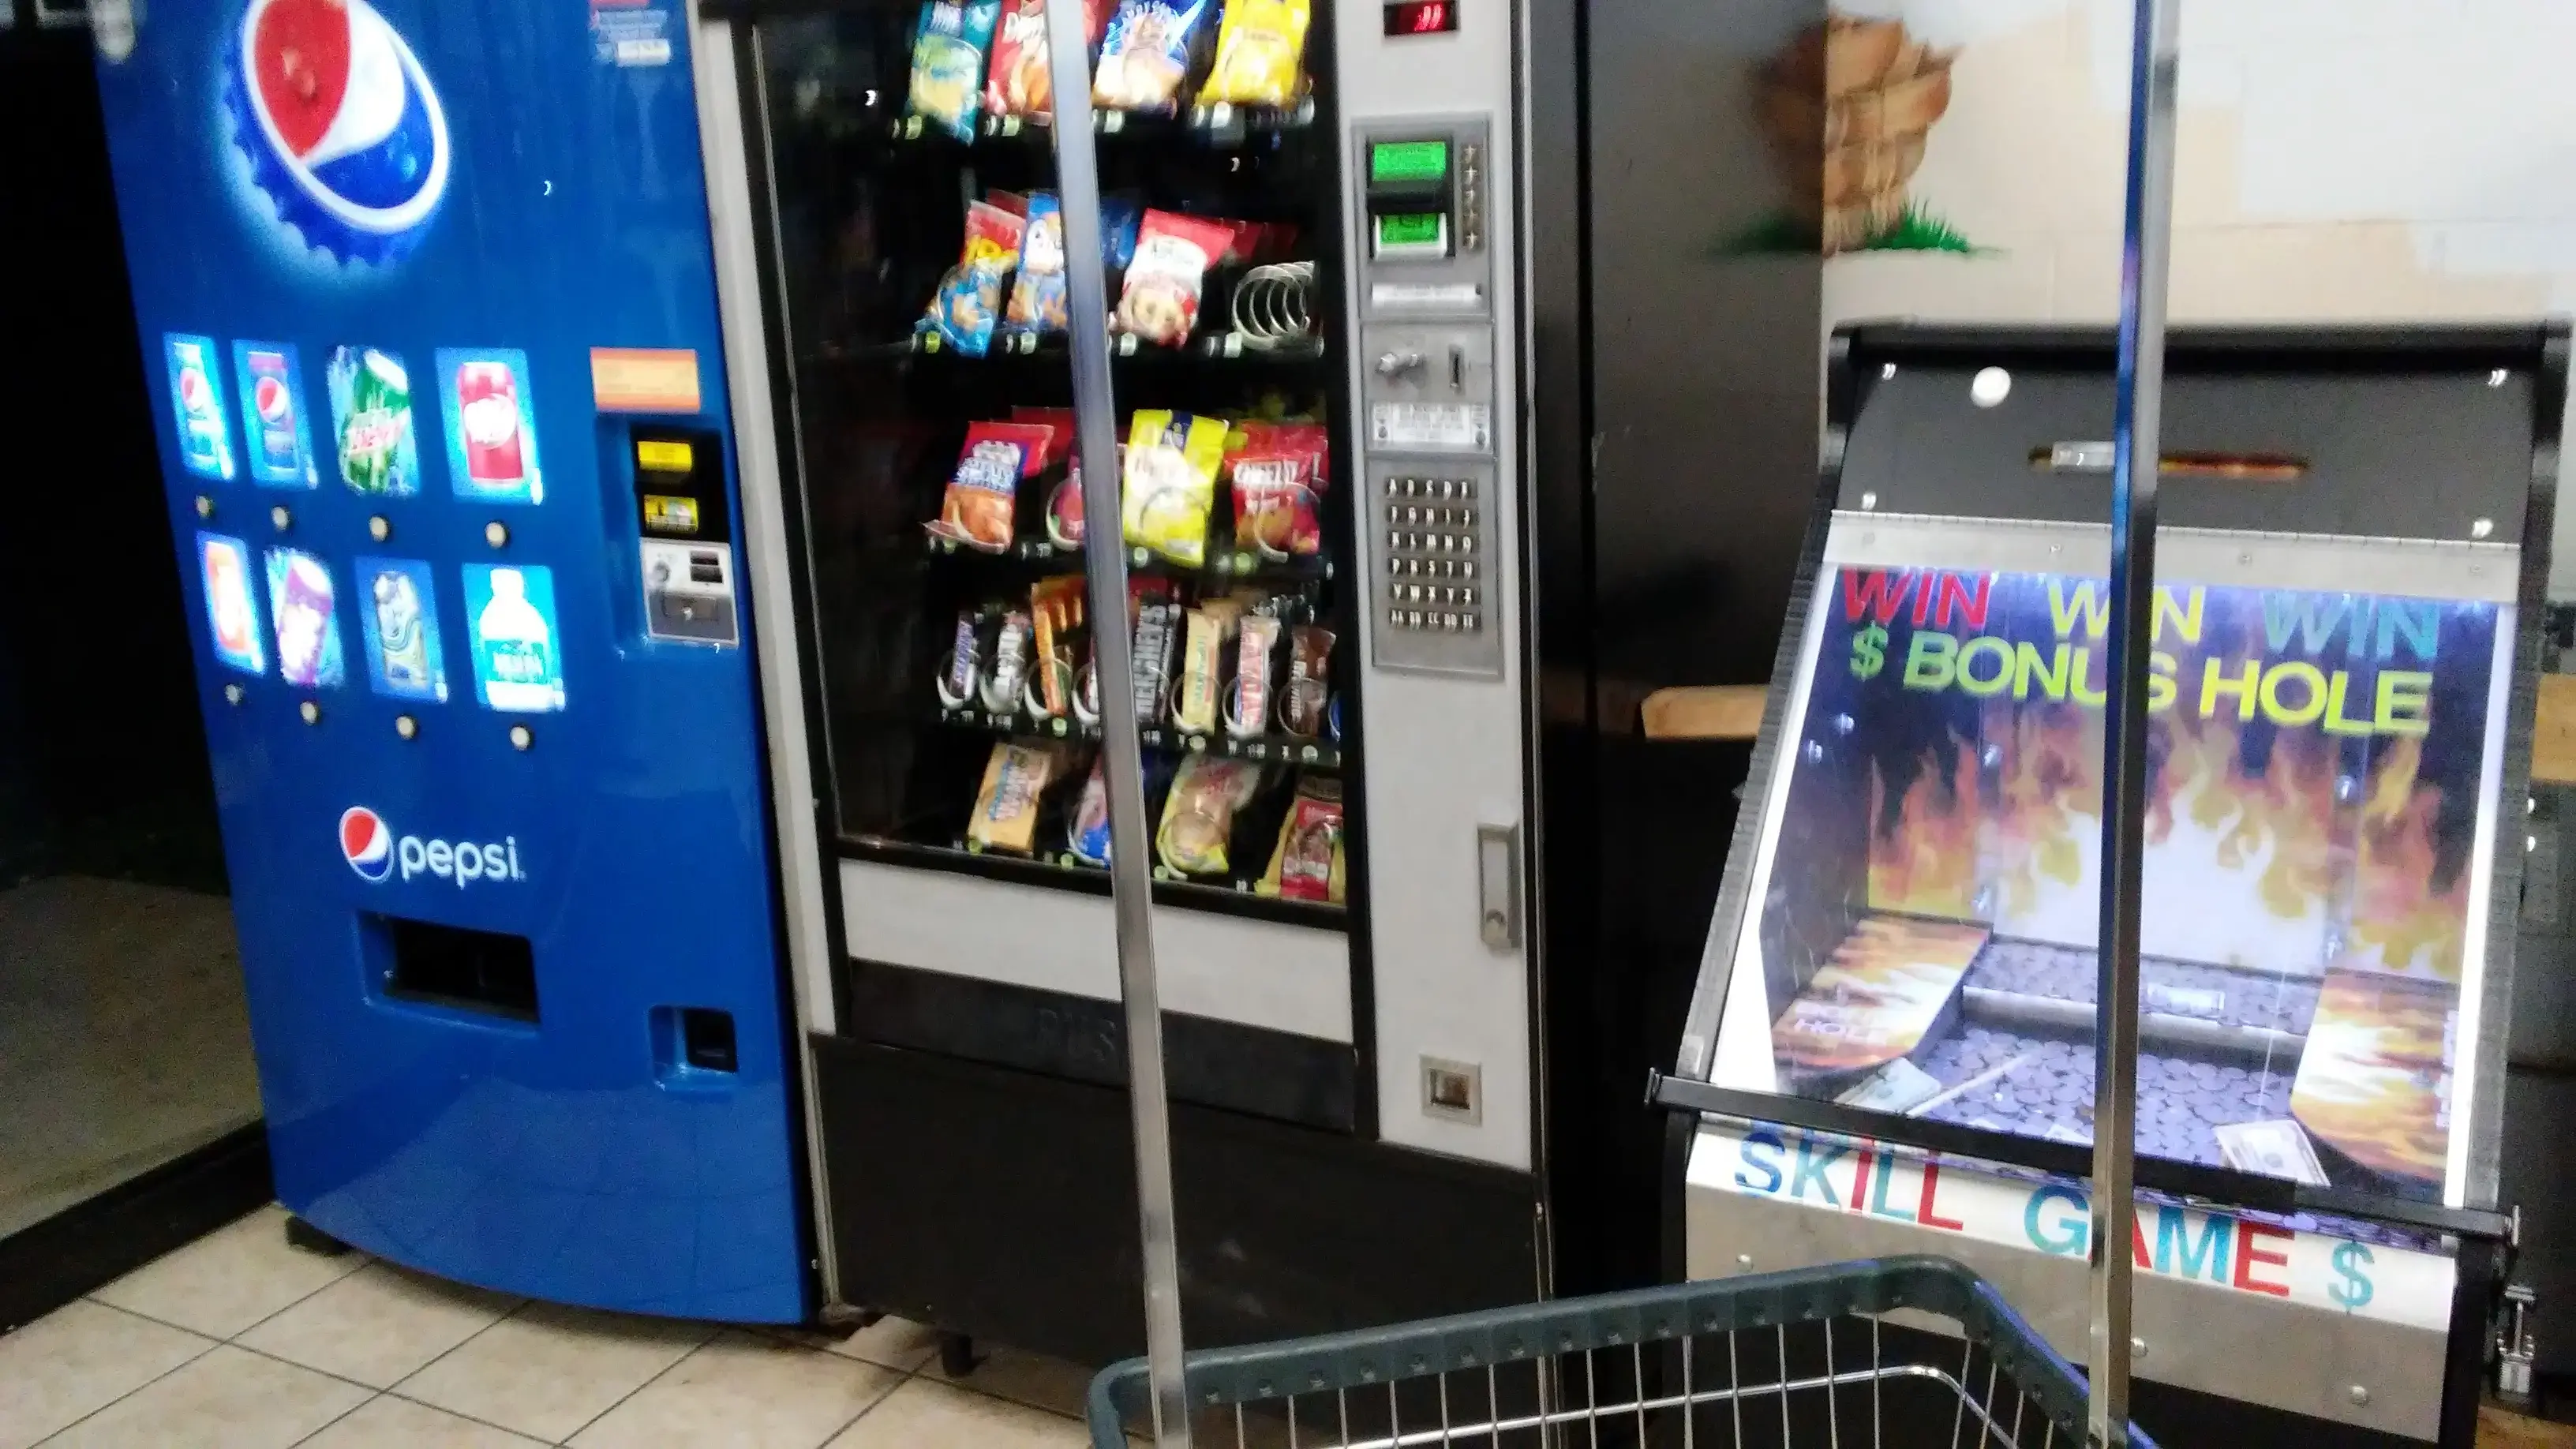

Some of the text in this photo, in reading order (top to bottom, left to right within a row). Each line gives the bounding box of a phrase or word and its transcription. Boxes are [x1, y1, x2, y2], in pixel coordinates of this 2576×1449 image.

[1844, 567, 2440, 661] WIN WN WIN
[1850, 620, 2434, 738] $ BONUS HOLE
[399, 835, 520, 890] pepsi
[1734, 1129, 1964, 1232] SKILL
[2327, 1237, 2376, 1315] $
